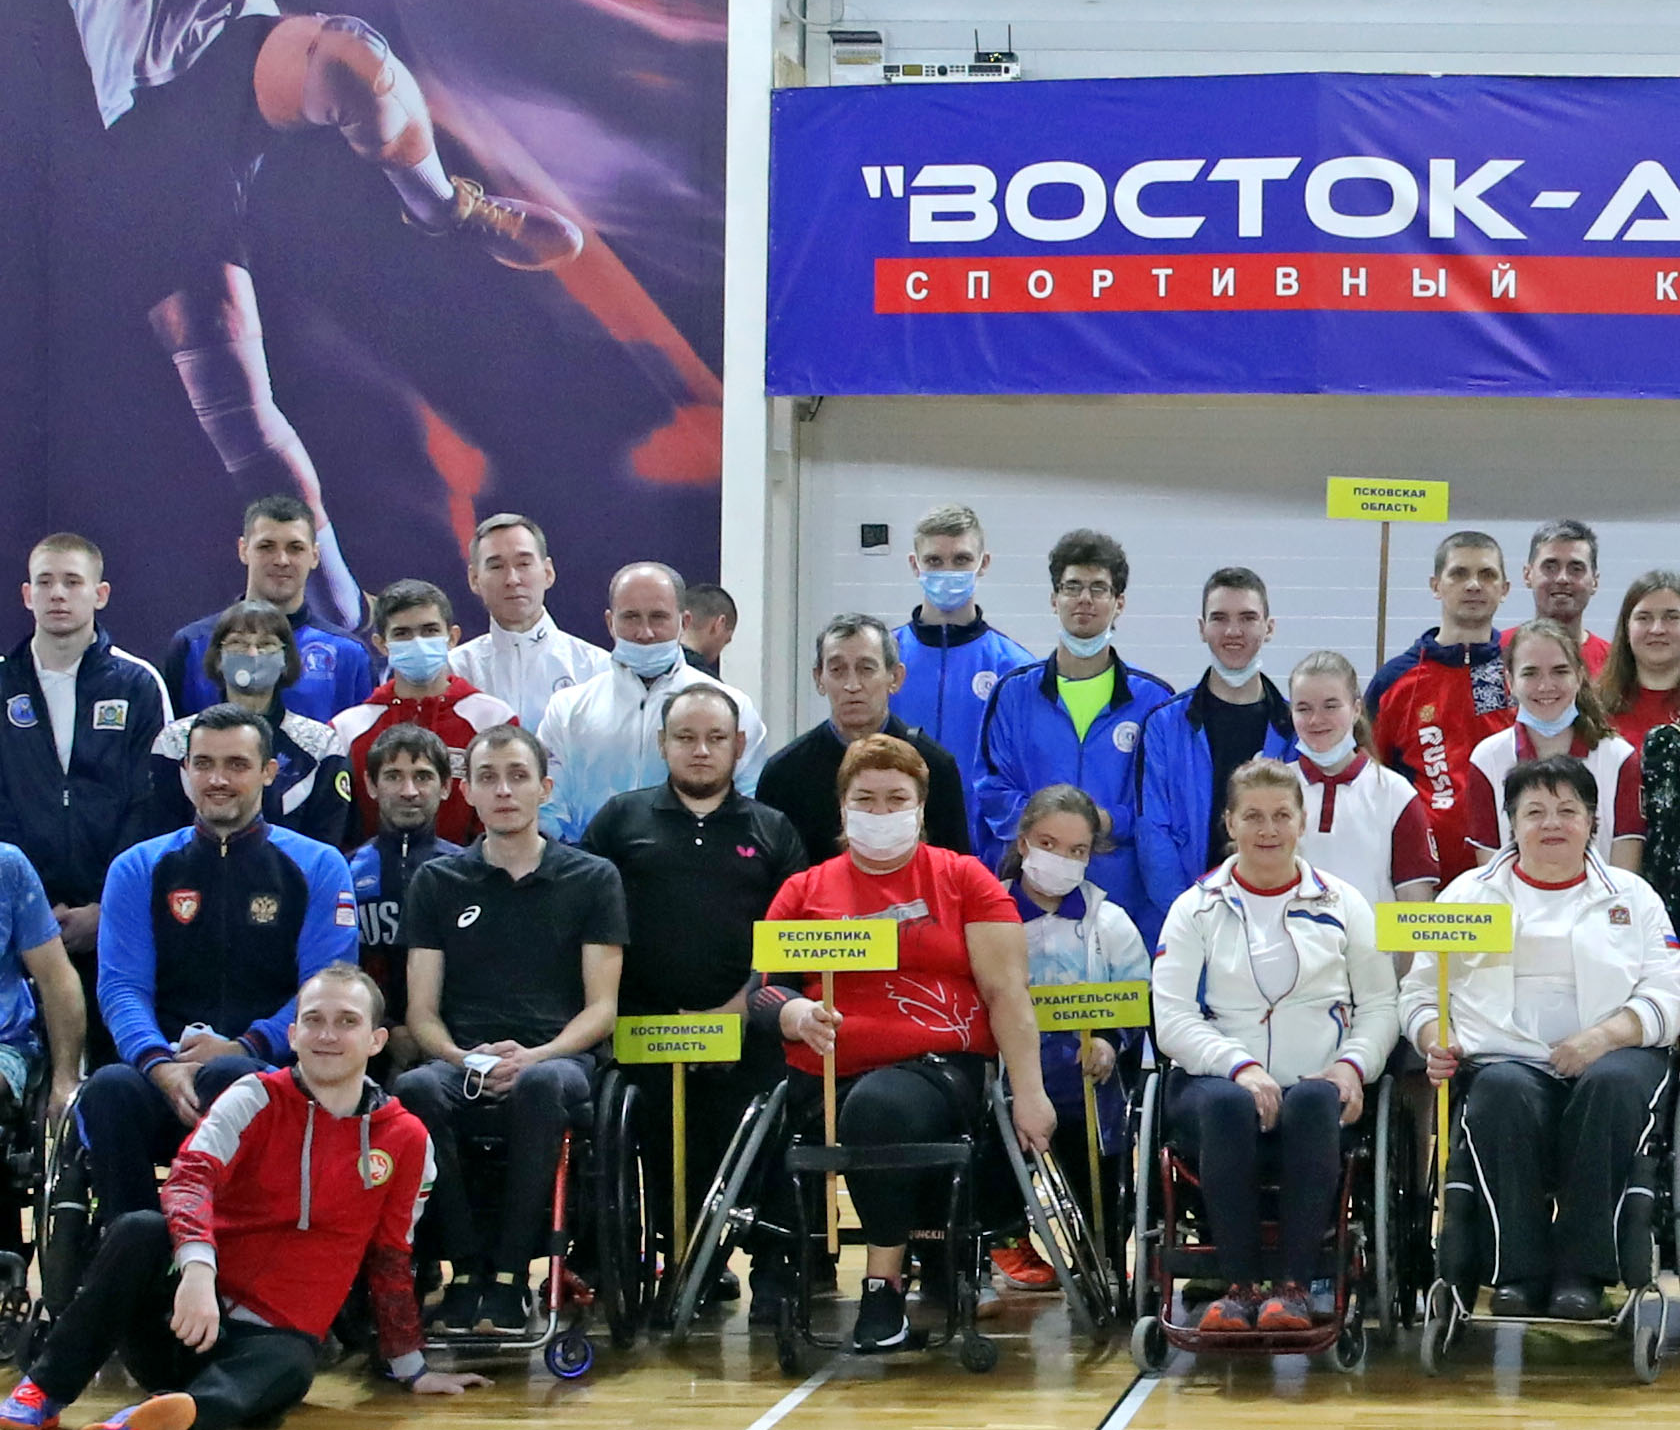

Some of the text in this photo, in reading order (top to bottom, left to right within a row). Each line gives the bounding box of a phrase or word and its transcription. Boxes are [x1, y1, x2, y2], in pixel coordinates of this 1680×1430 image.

[906, 262, 1517, 304] СПОРТИВНЫЙ
[1352, 487, 1426, 498] ПСКОВСКАЯ
[1361, 502, 1418, 513] ОБЛАСТЬ
[1417, 724, 1457, 810] RUSSIA
[1397, 912, 1492, 924] МОСКОВСКАЯ
[777, 931, 871, 942] РЕСПУБЛИКА
[1412, 930, 1477, 941] ОБЛАСТЬ
[783, 948, 866, 959] ТАТАРСТАН
[1052, 1007, 1115, 1020] ОБЛАСТЬ
[630, 1025, 724, 1036] КОСТРОМСКАЯ
[647, 1041, 706, 1052] ОБЛАСТЬ
